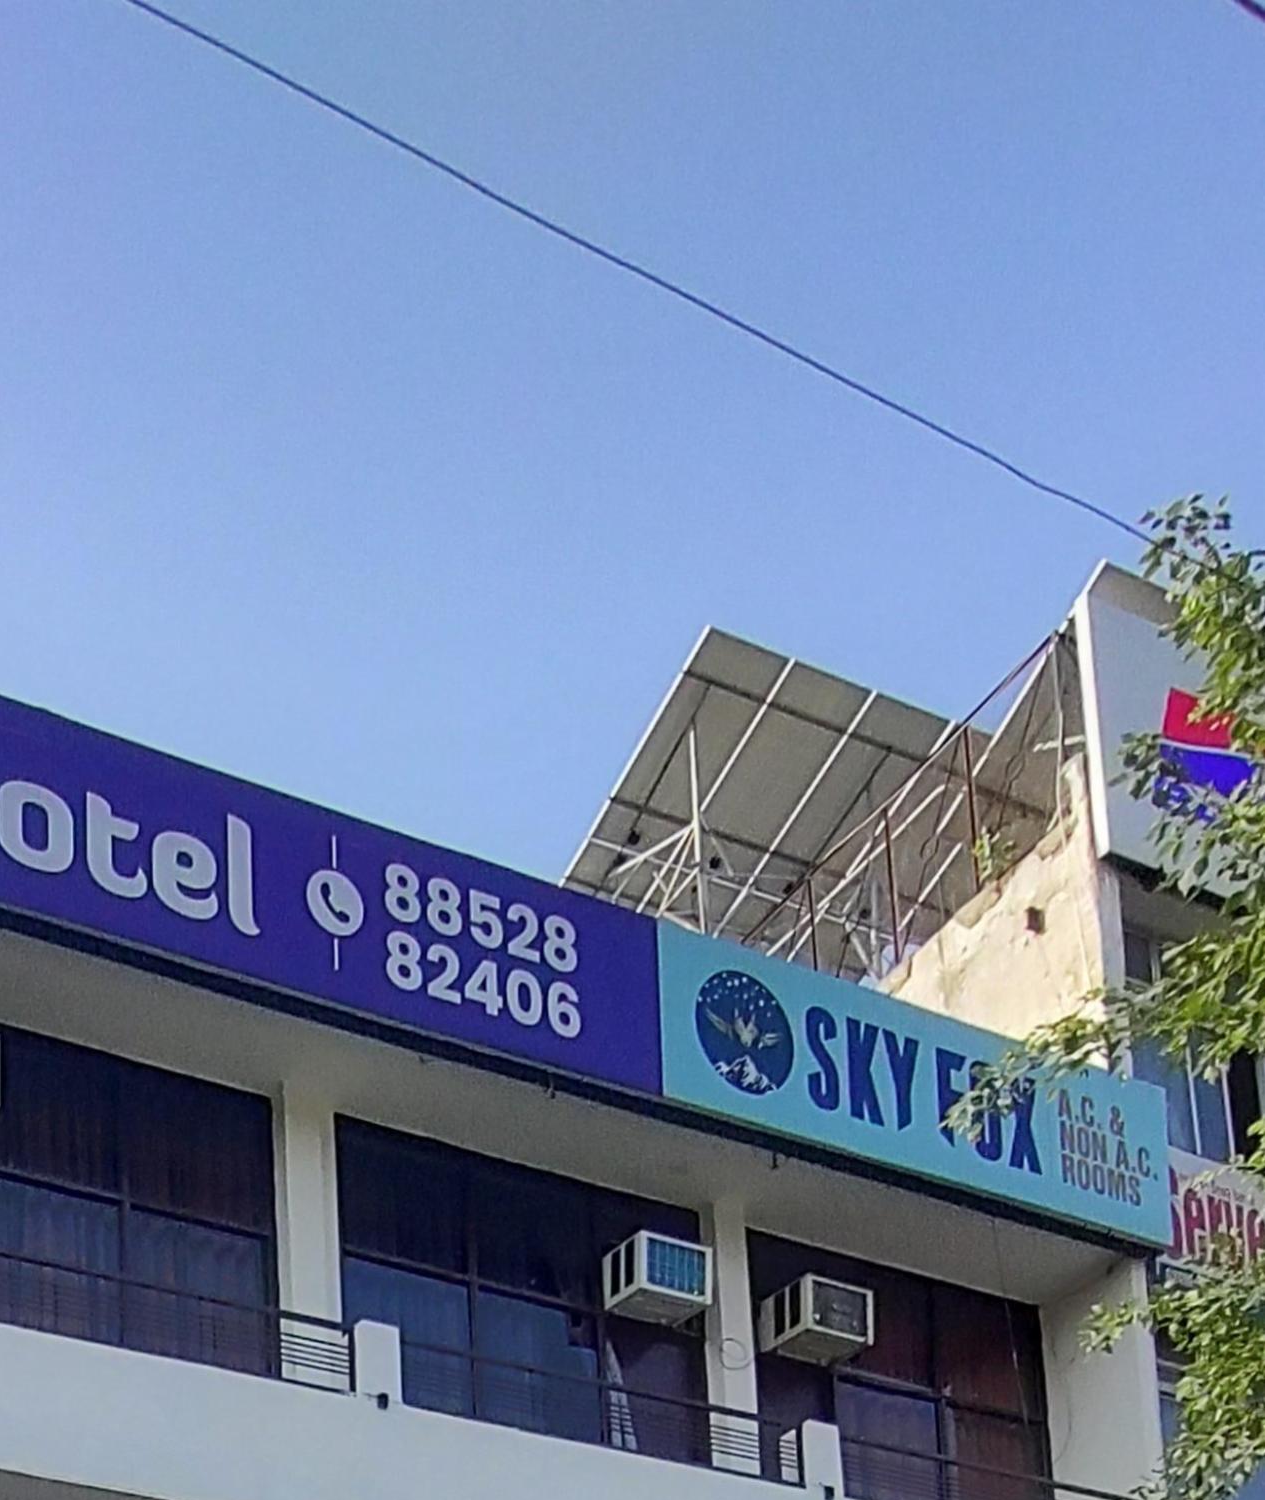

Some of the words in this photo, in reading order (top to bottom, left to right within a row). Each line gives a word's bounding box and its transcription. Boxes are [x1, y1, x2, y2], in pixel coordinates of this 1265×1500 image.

[384, 862, 579, 974] 88528
[384, 929, 582, 1040] 82406
[805, 1005, 919, 1132] SKY
[1057, 1088, 1103, 1129] A.C.
[1108, 1105, 1125, 1139] &
[1059, 1119, 1108, 1163] NON
[1115, 1136, 1159, 1180] A.C.
[1062, 1153, 1141, 1208] ROOMS
